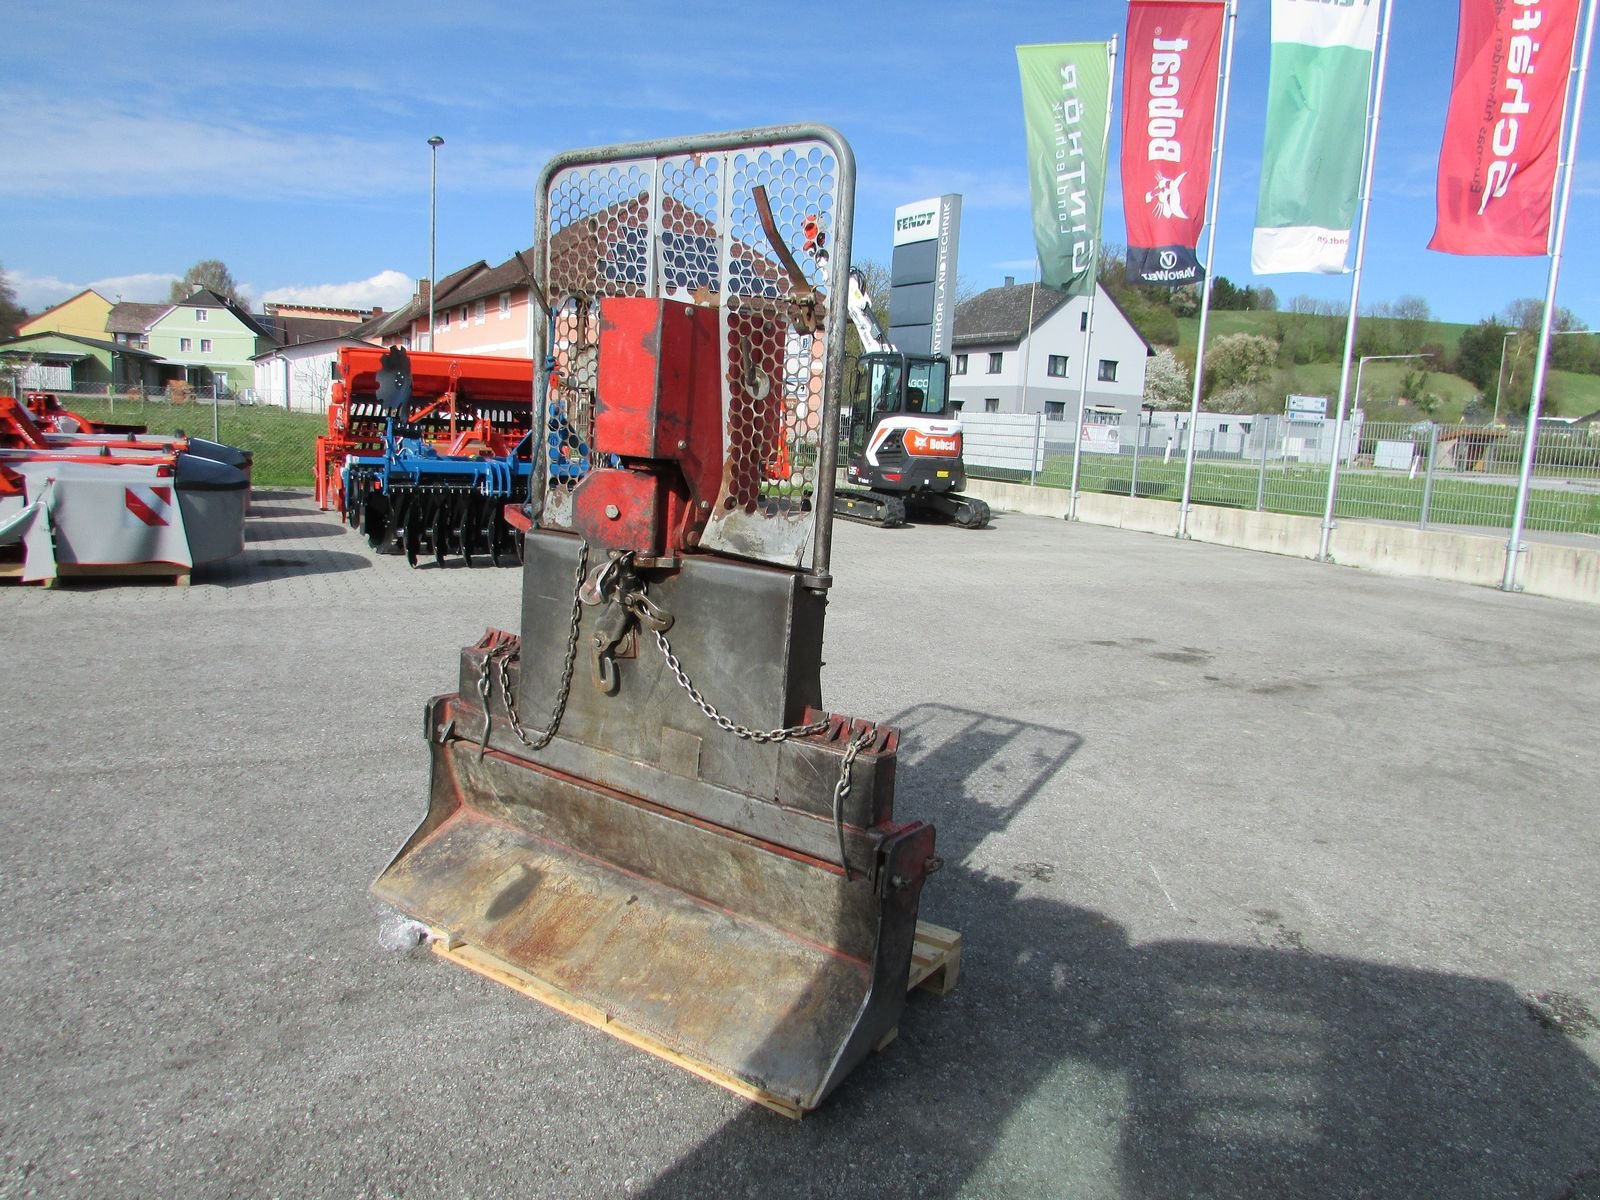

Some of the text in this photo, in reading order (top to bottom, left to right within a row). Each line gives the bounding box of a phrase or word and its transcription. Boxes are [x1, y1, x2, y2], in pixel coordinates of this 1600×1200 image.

[897, 211, 936, 231] FENDT
[938, 202, 951, 299] LANDTECHNIK
[929, 438, 956, 451] Bobcat
